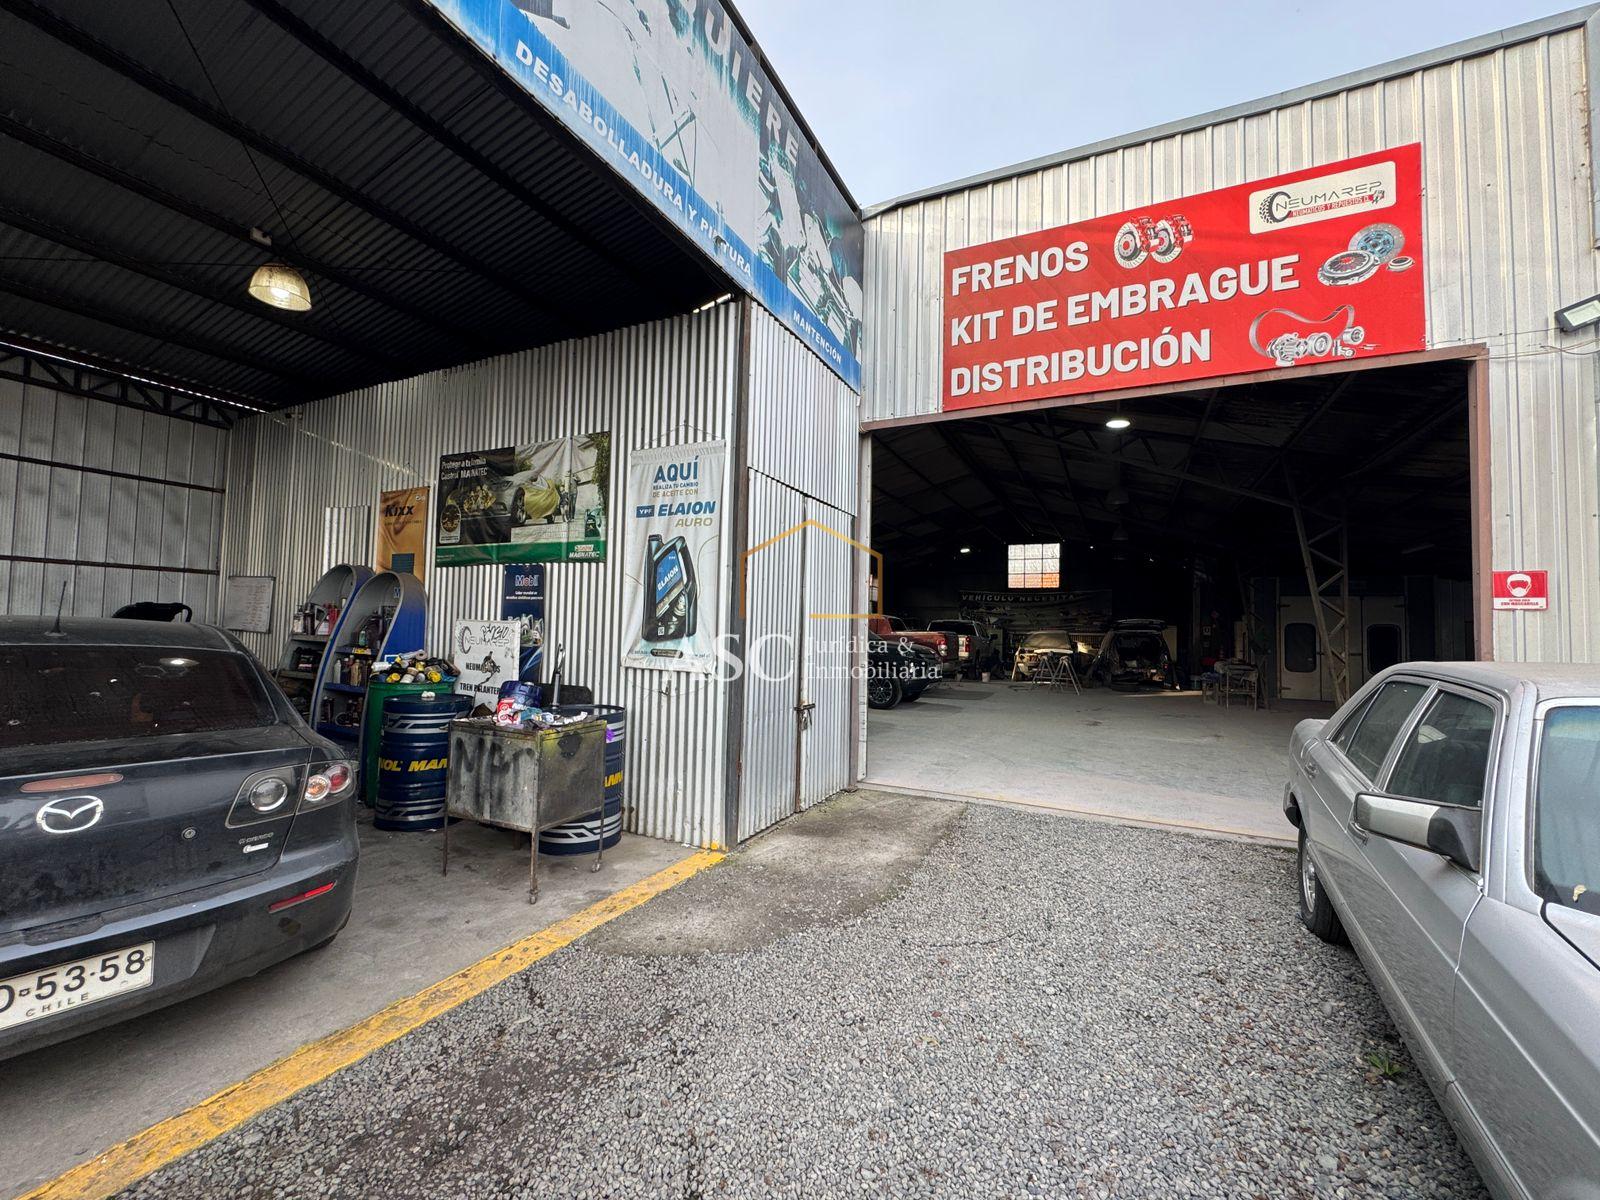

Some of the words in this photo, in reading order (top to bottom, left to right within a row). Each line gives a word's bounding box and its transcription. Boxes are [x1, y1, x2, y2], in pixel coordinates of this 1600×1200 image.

[680, 0, 799, 167] UIERE
[515, 39, 683, 211] DESABOLLADURA
[688, 204, 698, 221] Y
[951, 240, 1089, 297] FRENOS
[950, 309, 1005, 347] KIT
[1012, 302, 1058, 337] DE
[1067, 253, 1301, 326] EMBRAGUE
[793, 309, 842, 365] MANTENCIÓN
[950, 326, 1212, 398] DISTRIBUCIÓN
[653, 455, 699, 483] AQUÍ
[657, 501, 716, 517] ELAION
[675, 517, 713, 527] AURO
[25, 991, 89, 1018] CHILE
